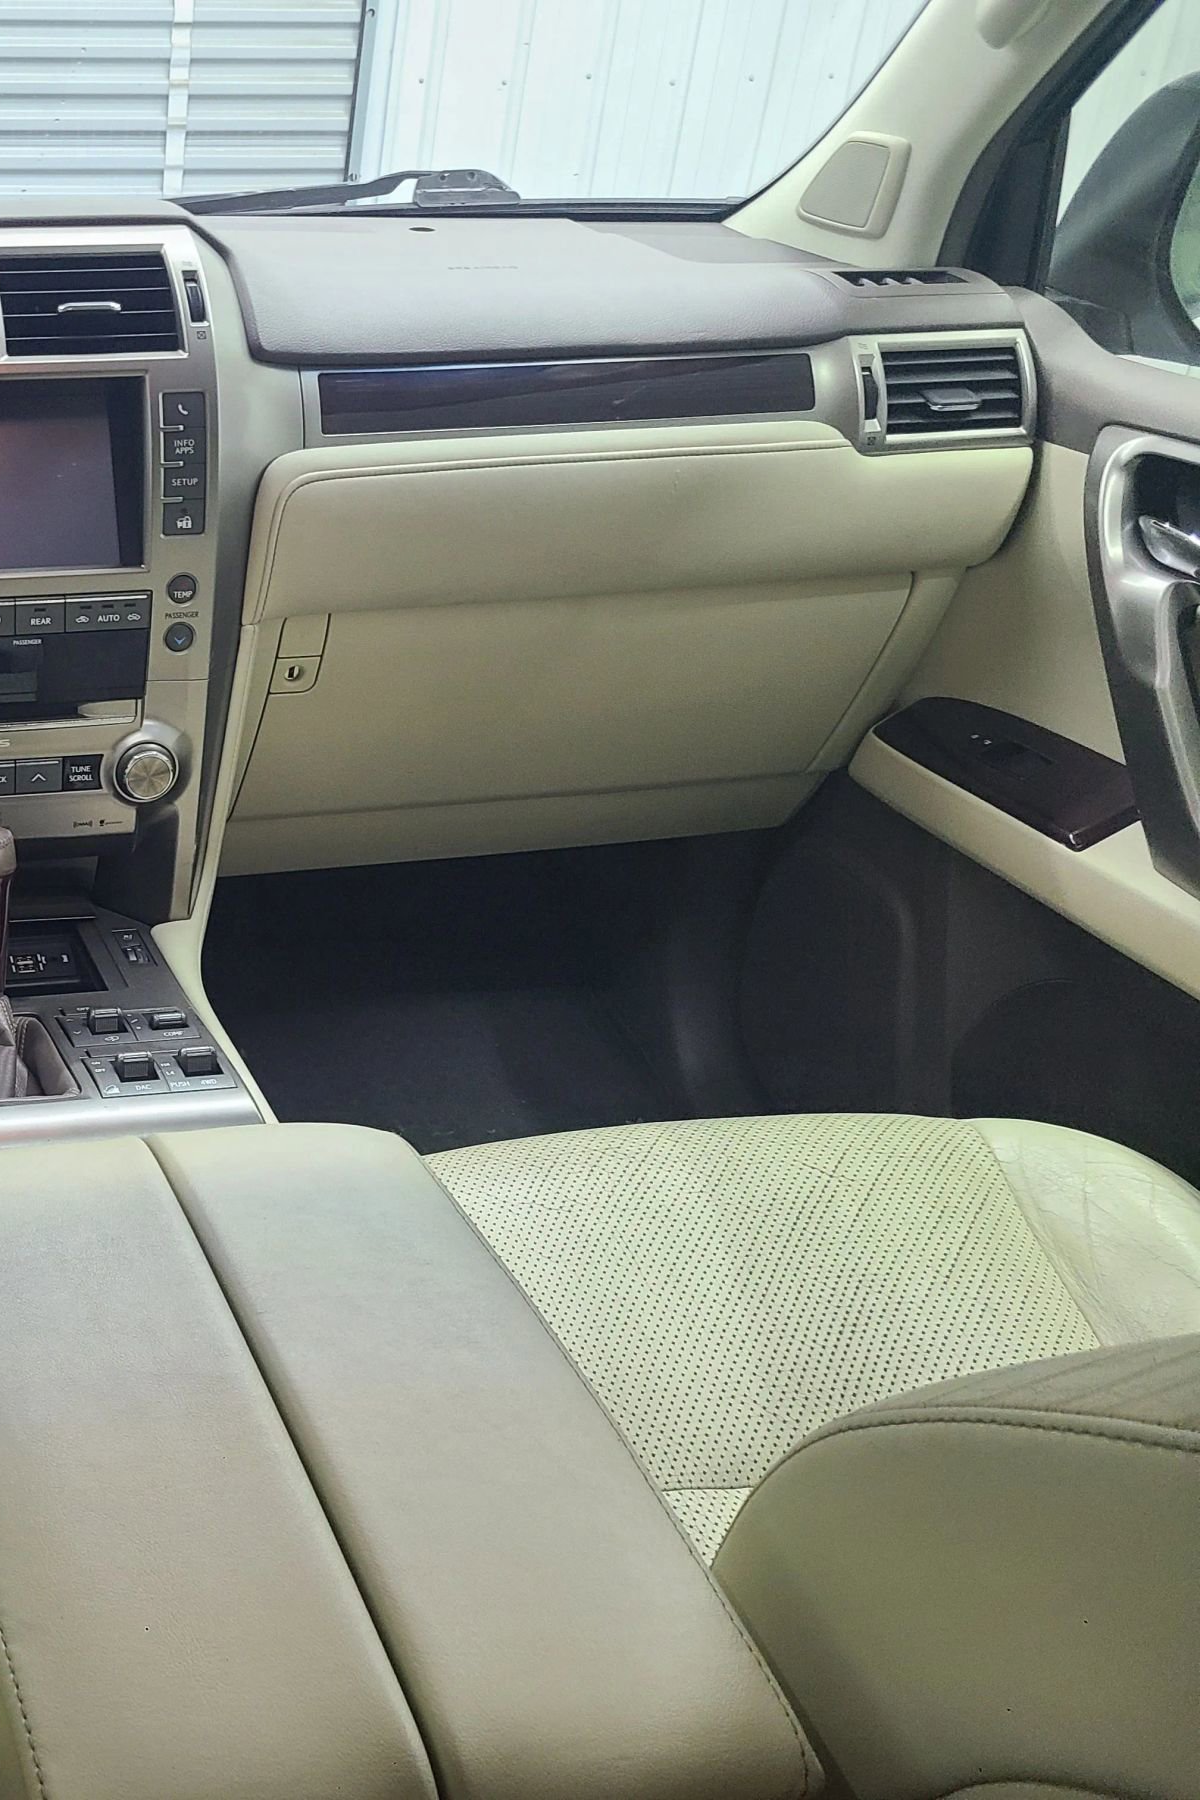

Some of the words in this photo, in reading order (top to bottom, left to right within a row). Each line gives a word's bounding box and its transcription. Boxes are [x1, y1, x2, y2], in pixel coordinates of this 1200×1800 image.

[175, 447, 194, 455] APPS
[171, 478, 198, 486] SETUP
[173, 591, 192, 599] TEMP
[31, 617, 51, 626] REAR
[97, 614, 120, 622] AUTO
[69, 773, 93, 782] SCROLL
